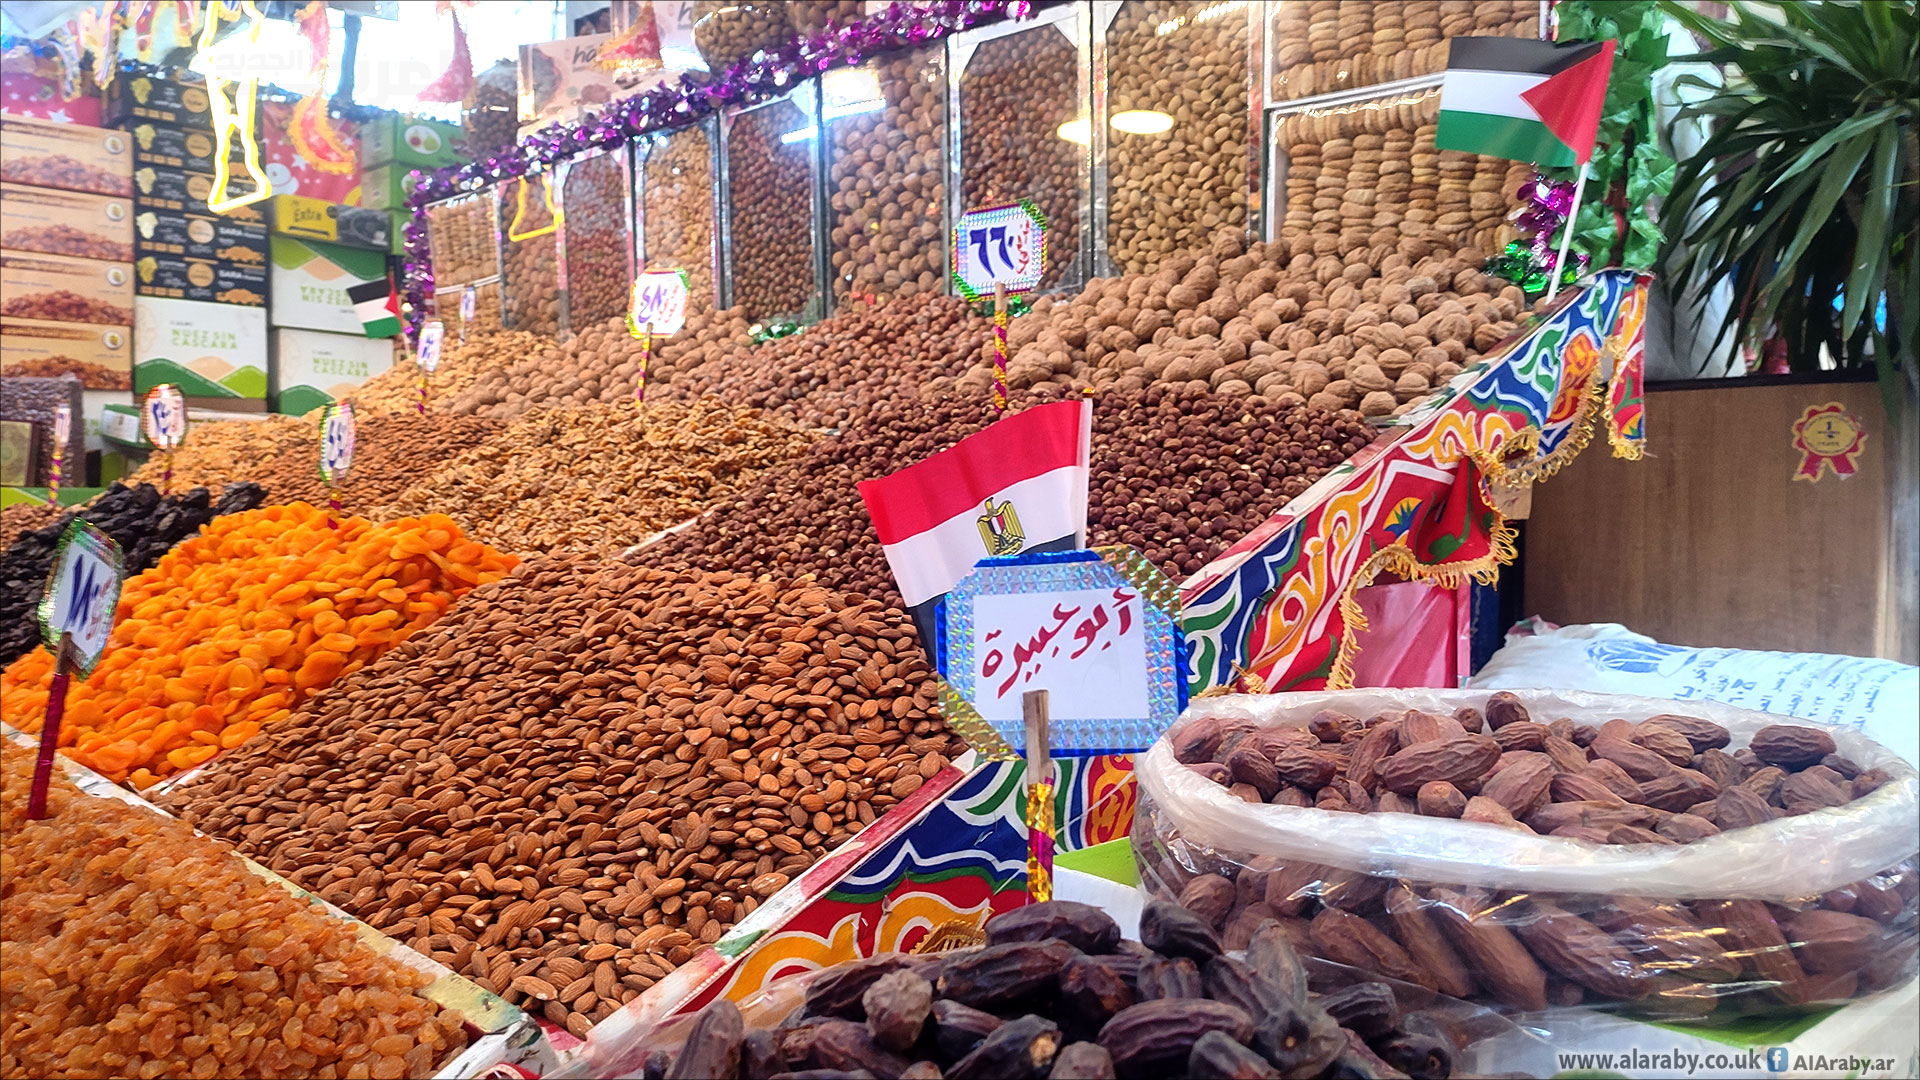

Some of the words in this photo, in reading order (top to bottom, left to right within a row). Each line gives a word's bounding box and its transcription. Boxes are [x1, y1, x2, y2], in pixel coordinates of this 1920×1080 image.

[172, 328, 209, 339] NUEZ
[213, 331, 236, 341] SIN
[172, 338, 237, 349] CASCARA
[313, 357, 345, 366] NUEZ
[349, 360, 368, 369] SIN
[313, 365, 369, 377] CASCARA
[1071, 587, 1136, 660] أبو
[982, 602, 1081, 699] عبيرة
